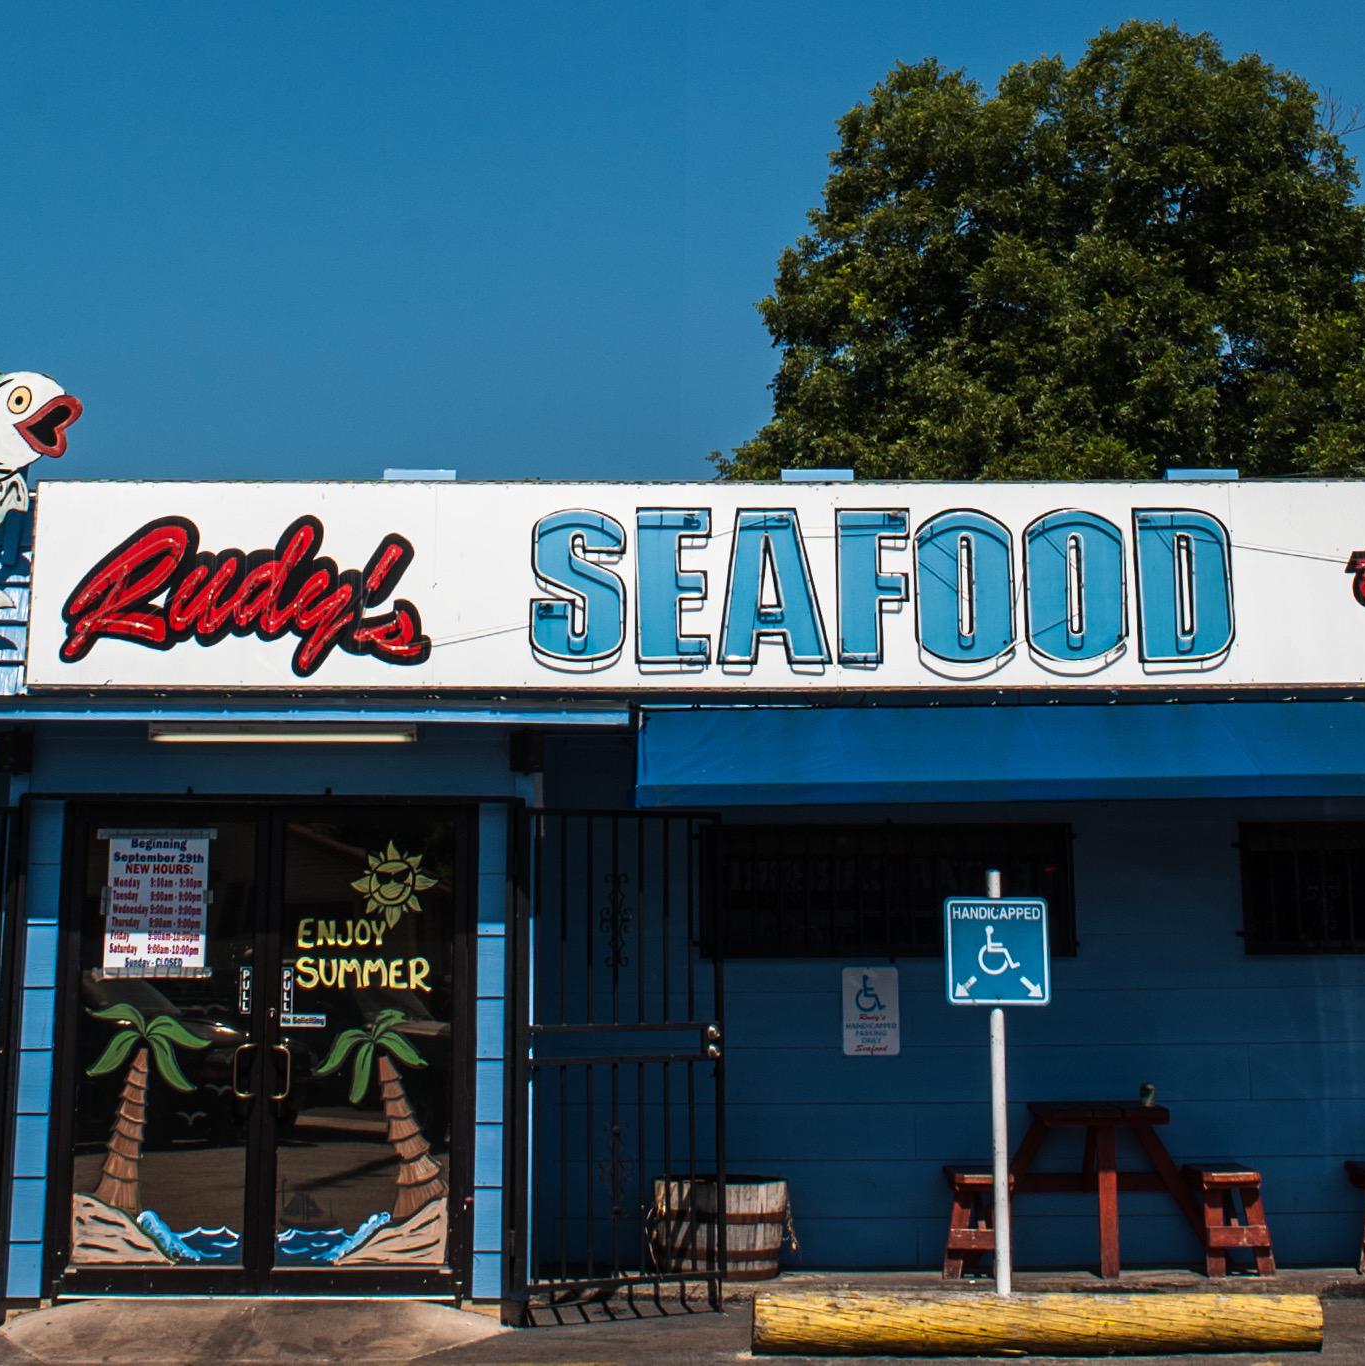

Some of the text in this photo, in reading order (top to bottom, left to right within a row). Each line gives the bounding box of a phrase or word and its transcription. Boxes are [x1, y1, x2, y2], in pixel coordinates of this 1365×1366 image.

[59, 514, 431, 677] Rudy's
[529, 507, 1236, 672] SEAFOOD
[131, 839, 187, 851] Beginning
[114, 852, 204, 864] September 29th
[125, 864, 193, 874] NEW HOURS:
[113, 878, 140, 889] Monday
[113, 891, 138, 902] Tuesday
[113, 904, 149, 917] Wednesday
[952, 906, 1041, 920] HANDICAPPED
[112, 917, 140, 929] Thursday
[110, 931, 130, 943] Friday
[297, 917, 387, 950] ENJOY
[109, 943, 138, 956] Saturday
[124, 957, 151, 968] Sunday
[155, 957, 183, 967] CLOSED
[296, 957, 432, 993] SUMMER
[242, 969, 251, 1011] PULL
[283, 970, 291, 1012] PULL
